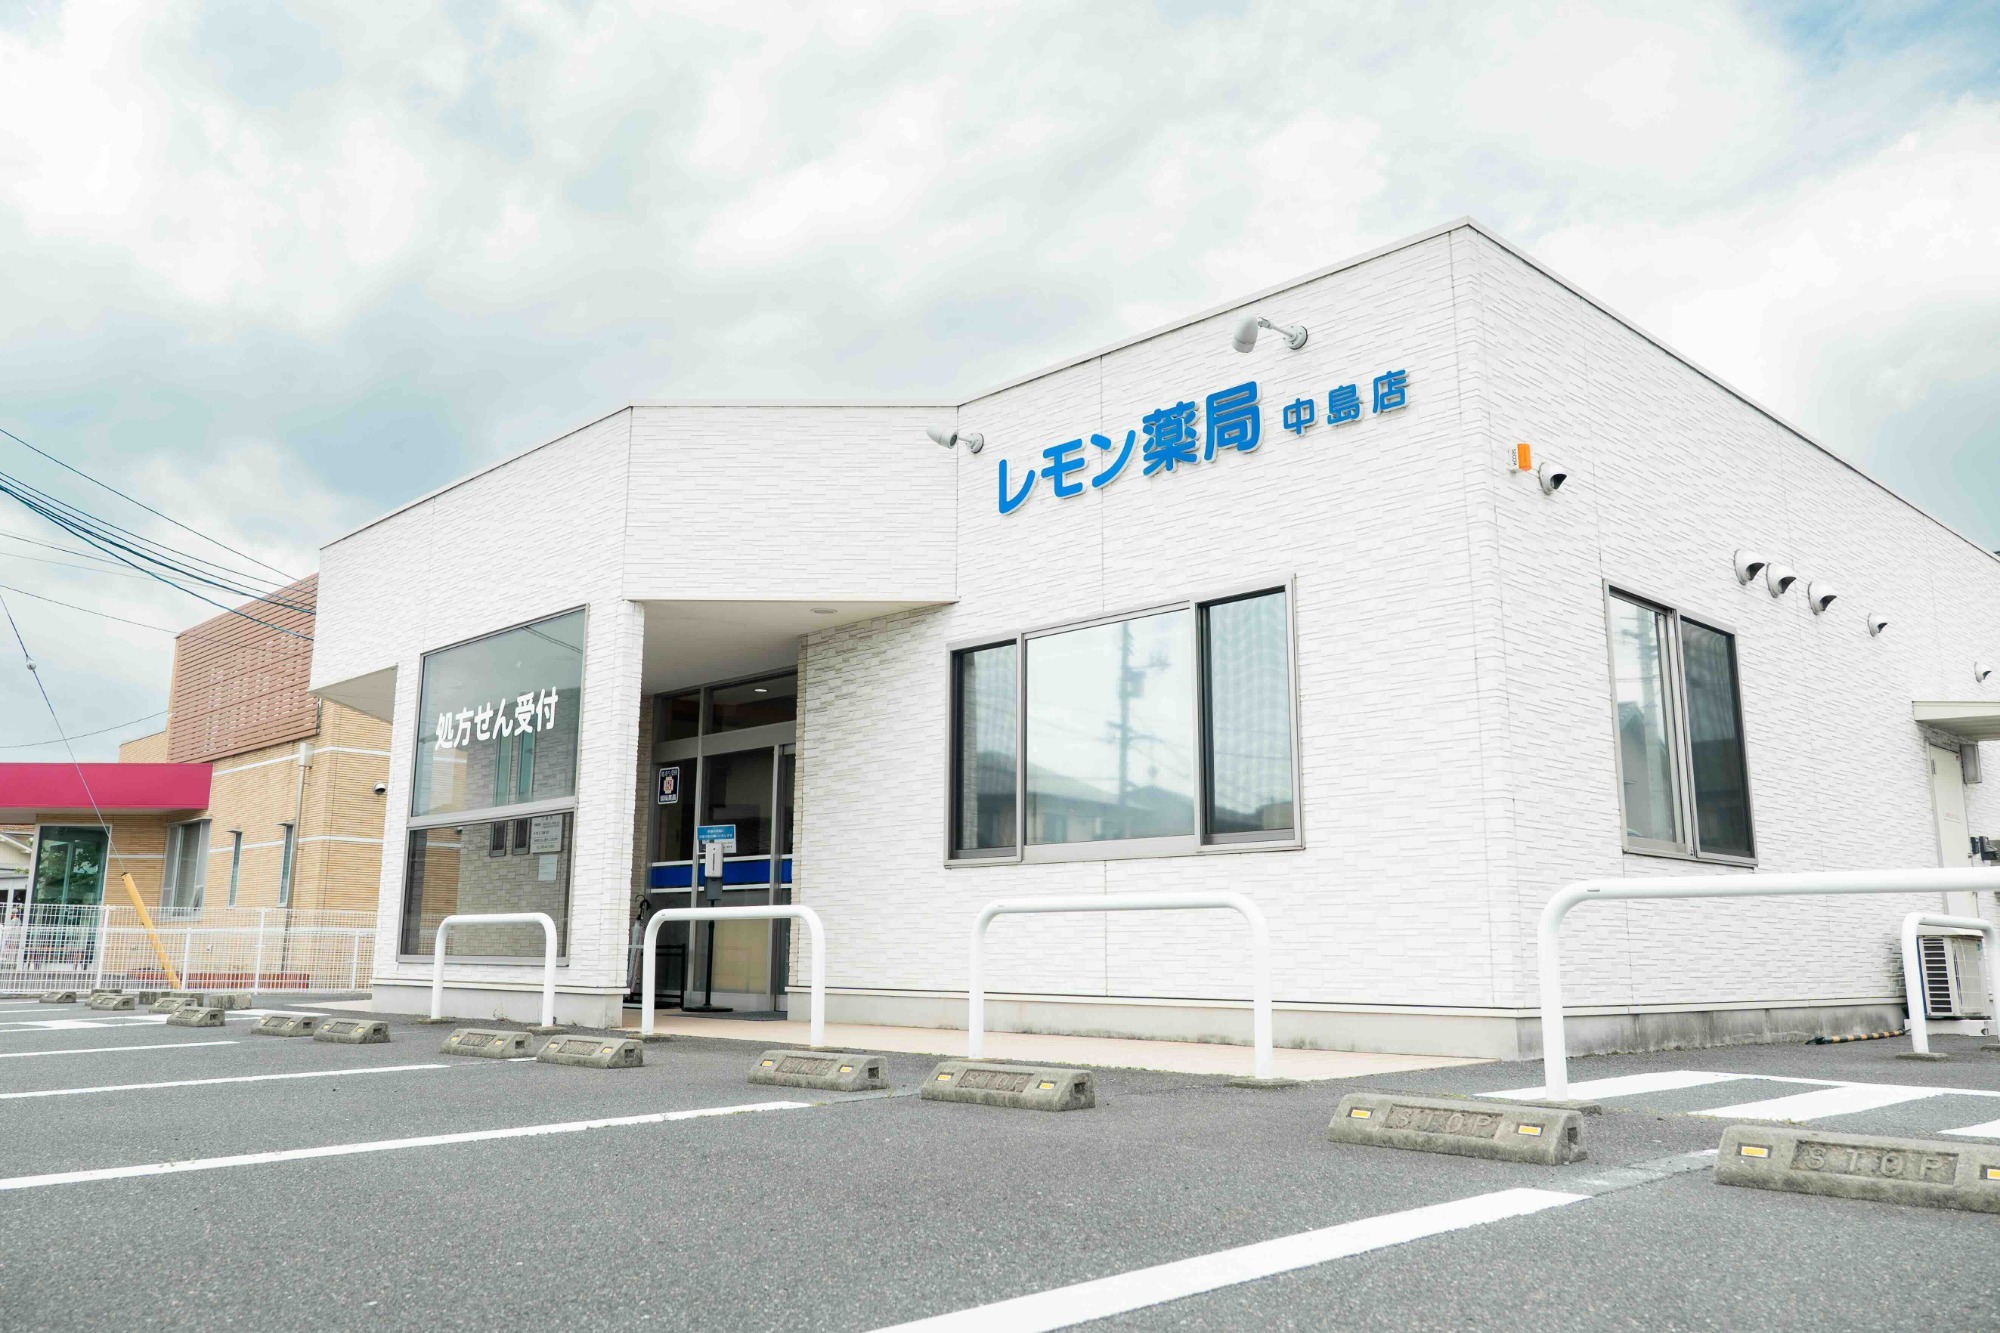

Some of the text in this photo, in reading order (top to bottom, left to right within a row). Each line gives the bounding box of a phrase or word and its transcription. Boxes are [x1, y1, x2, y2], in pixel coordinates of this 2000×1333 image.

[998, 368, 1408, 515] レモン薬局 中島店
[434, 686, 559, 751] 処方せん受付
[962, 1071, 1030, 1092] STOP
[1395, 1107, 1492, 1135] STOP
[1805, 1146, 1944, 1179] STOP
